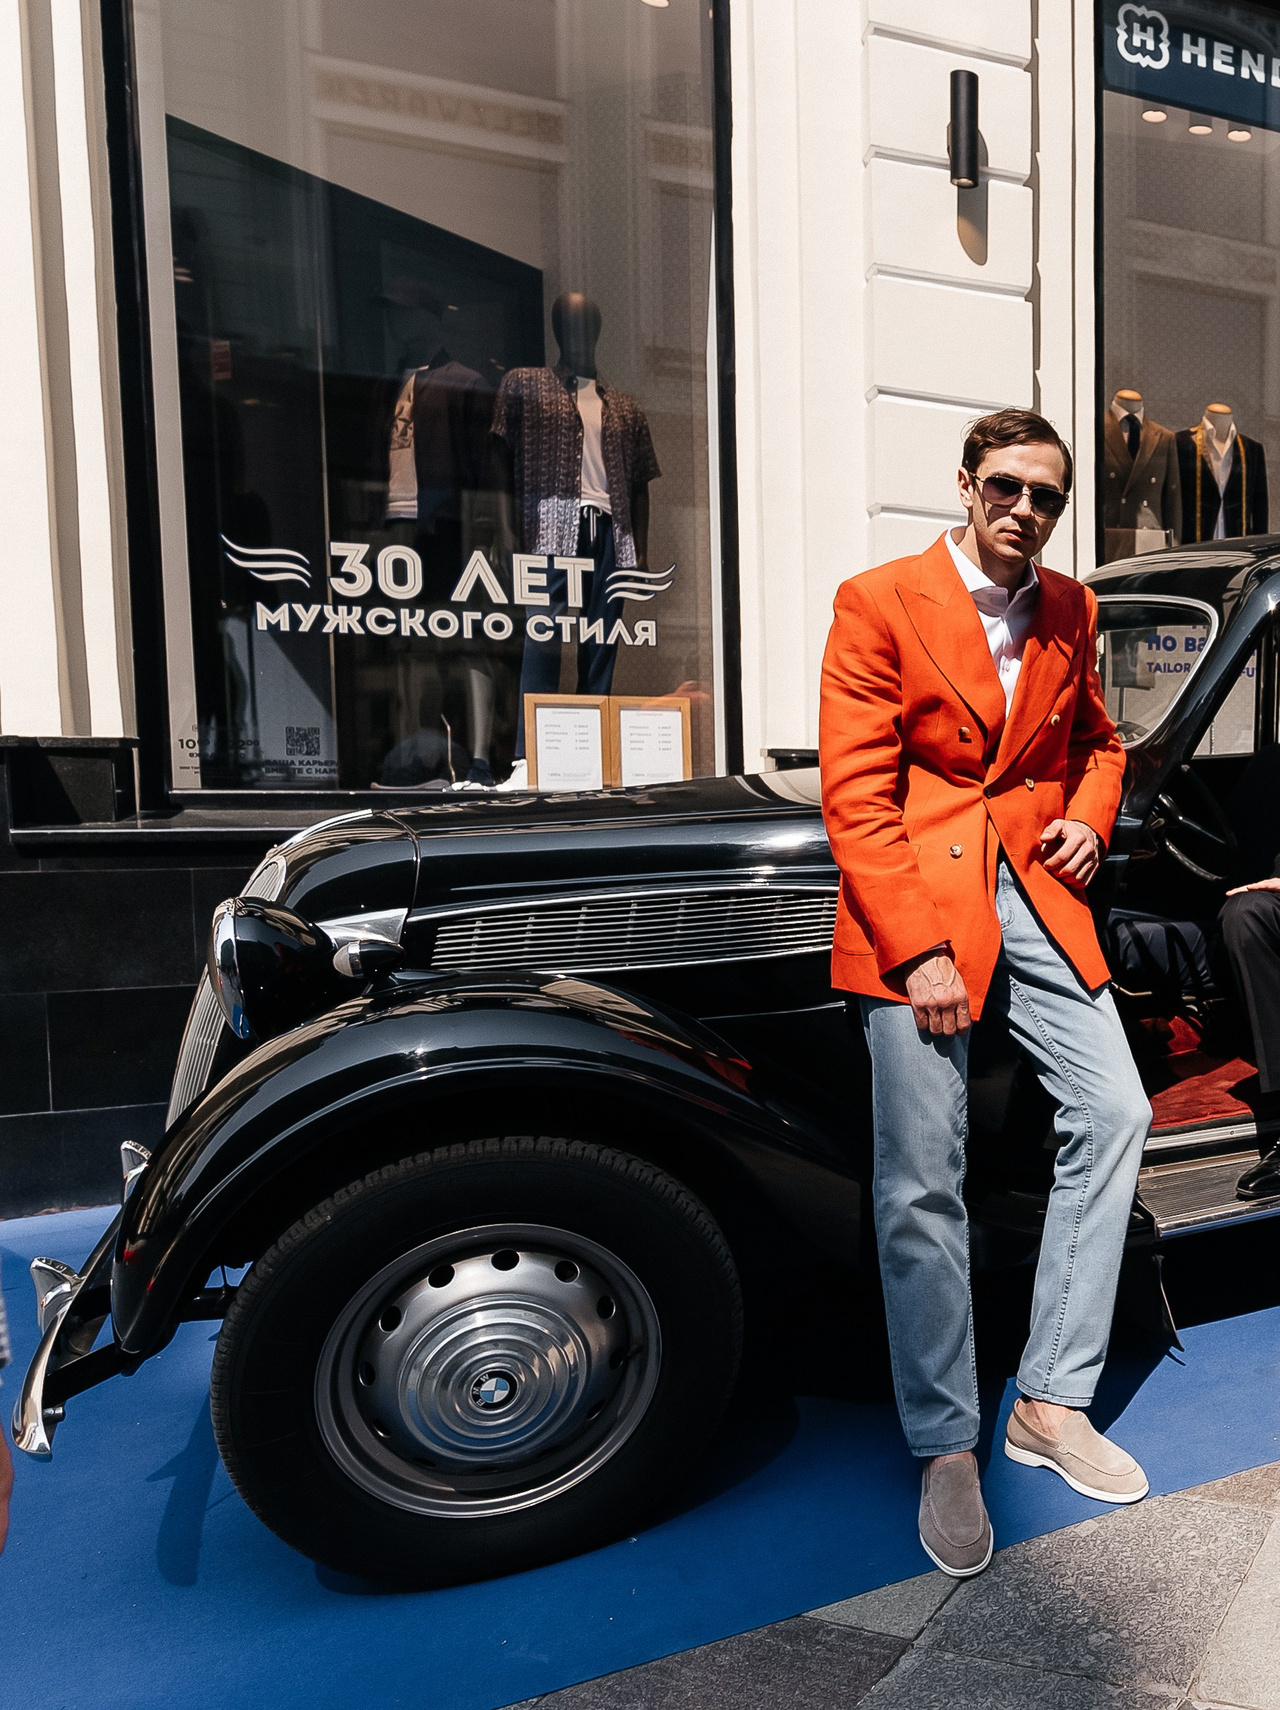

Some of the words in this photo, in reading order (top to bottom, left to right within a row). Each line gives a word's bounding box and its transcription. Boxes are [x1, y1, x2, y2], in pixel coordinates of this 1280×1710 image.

[329, 542, 423, 600] 30
[450, 550, 595, 608] ЛЕТ
[256, 602, 514, 641] МУЖСКОГО
[526, 614, 658, 647] СТИЛЯ
[1147, 635, 1177, 652] по
[1147, 661, 1191, 673] TAILOR
[472, 1374, 489, 1407] BMW
